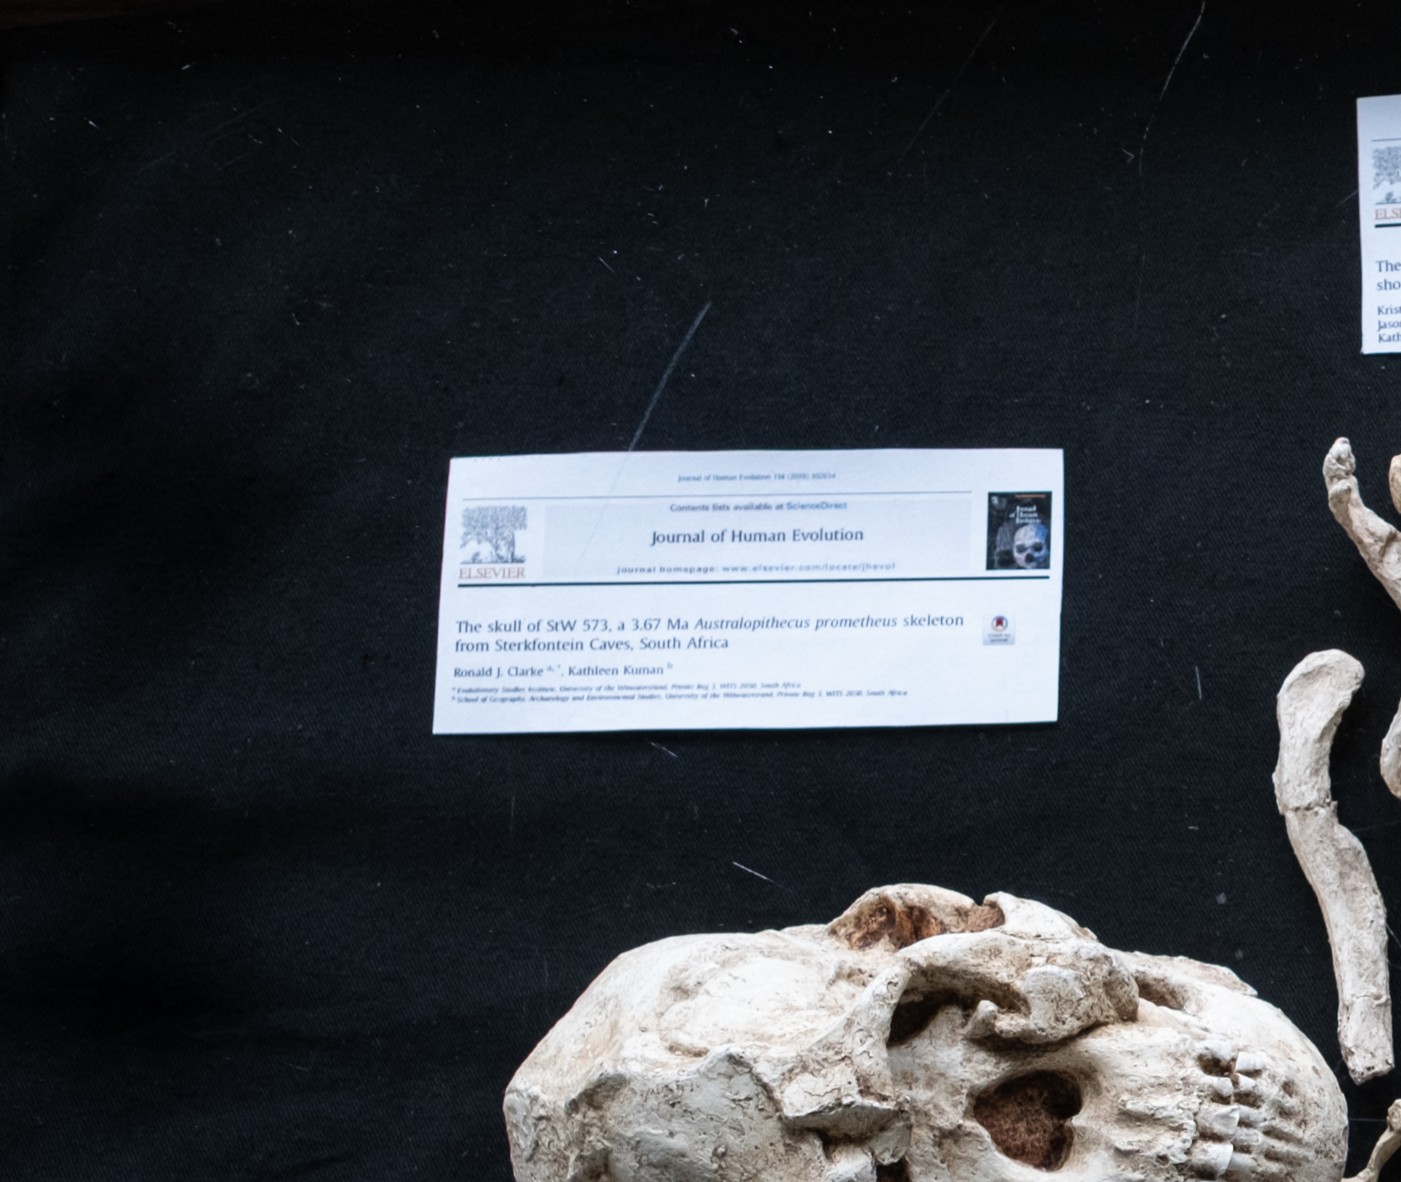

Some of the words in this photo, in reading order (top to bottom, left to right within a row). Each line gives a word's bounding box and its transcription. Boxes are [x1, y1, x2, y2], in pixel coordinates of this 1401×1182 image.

[1376, 259, 1401, 272] The
[652, 530, 705, 549] Journal
[711, 529, 727, 543] of
[731, 529, 786, 543] Human
[793, 528, 863, 542] Evolution
[459, 567, 526, 580] ELSEVIER
[456, 620, 482, 634] The
[488, 620, 521, 633] skull
[527, 619, 542, 633] of
[547, 619, 577, 633] StW
[583, 619, 612, 634] 573,
[618, 621, 625, 632] a
[632, 618, 661, 631] 3.67
[667, 617, 688, 631] Ma
[694, 617, 810, 634] Australopithecus
[815, 615, 897, 632] prometheus
[904, 614, 963, 628] skeleton
[455, 639, 489, 652] from
[495, 638, 583, 652] Sterkfontein
[589, 637, 633, 652] Caves,
[640, 636, 681, 650] South
[687, 636, 728, 649] Africa
[454, 667, 492, 678] Ronald
[497, 666, 503, 680] J.
[507, 666, 544, 677] Clarke
[568, 666, 618, 676] Kathleen
[623, 665, 663, 676] Kuman
